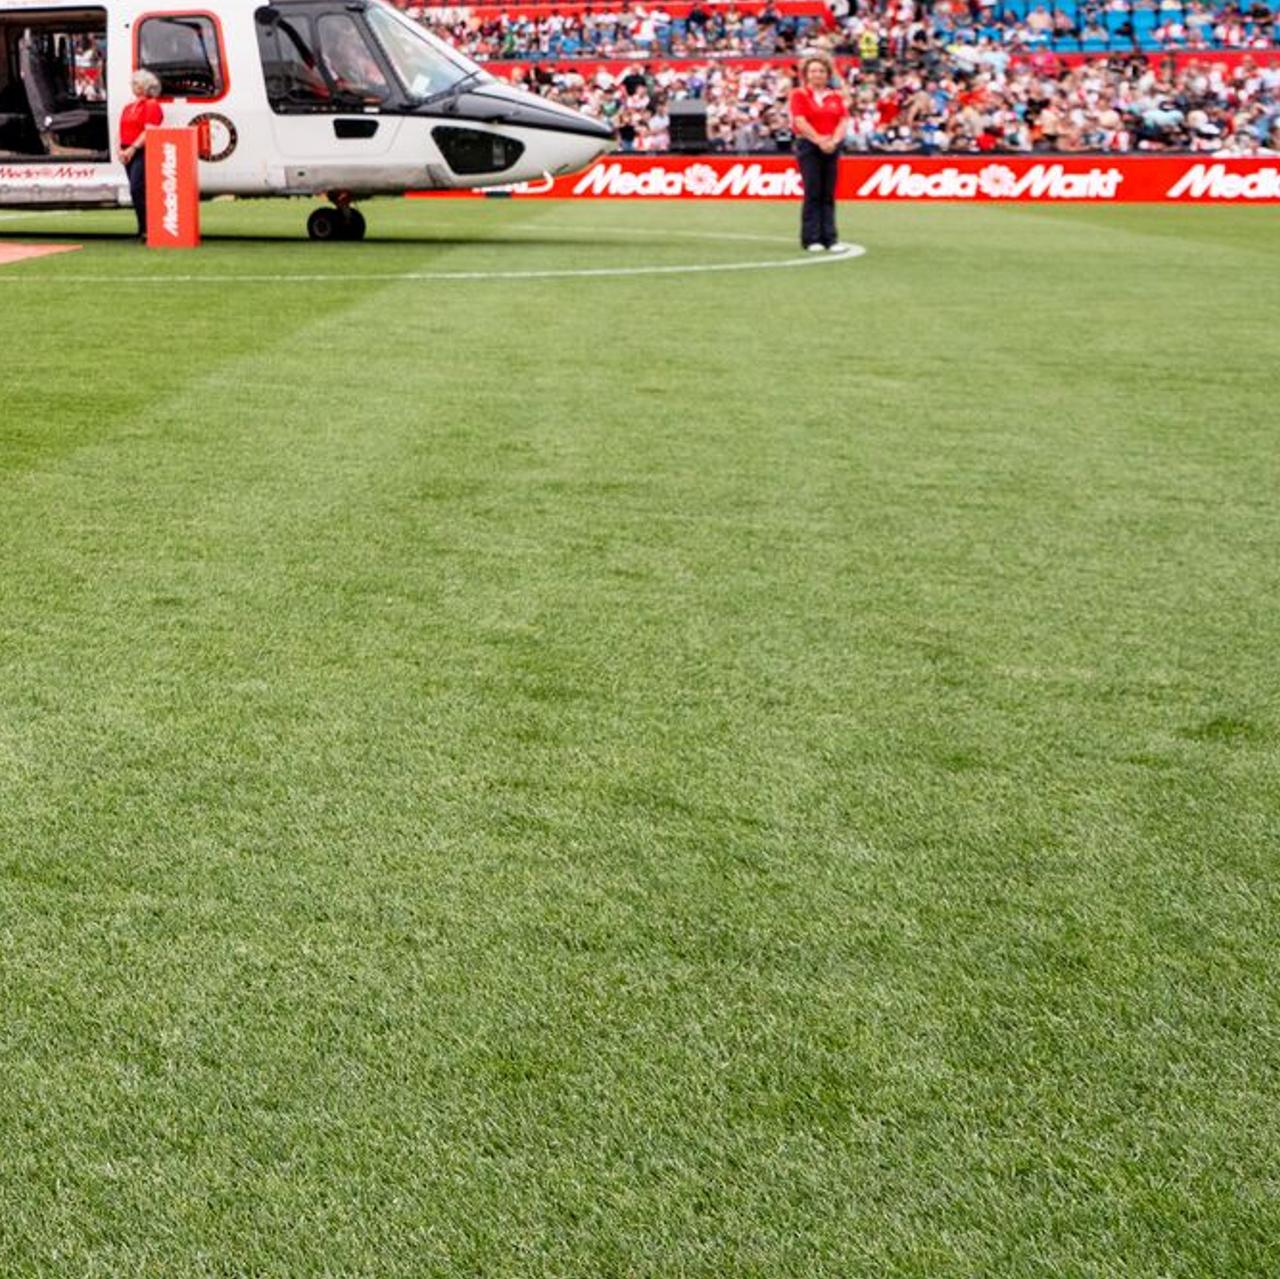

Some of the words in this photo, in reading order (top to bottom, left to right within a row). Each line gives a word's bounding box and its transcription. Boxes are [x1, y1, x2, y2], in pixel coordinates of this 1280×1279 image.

[573, 163, 682, 195] Media
[714, 163, 805, 196] Mark
[857, 164, 979, 197] Media
[1011, 164, 1124, 198] Markt
[1166, 164, 1280, 198] Medi
